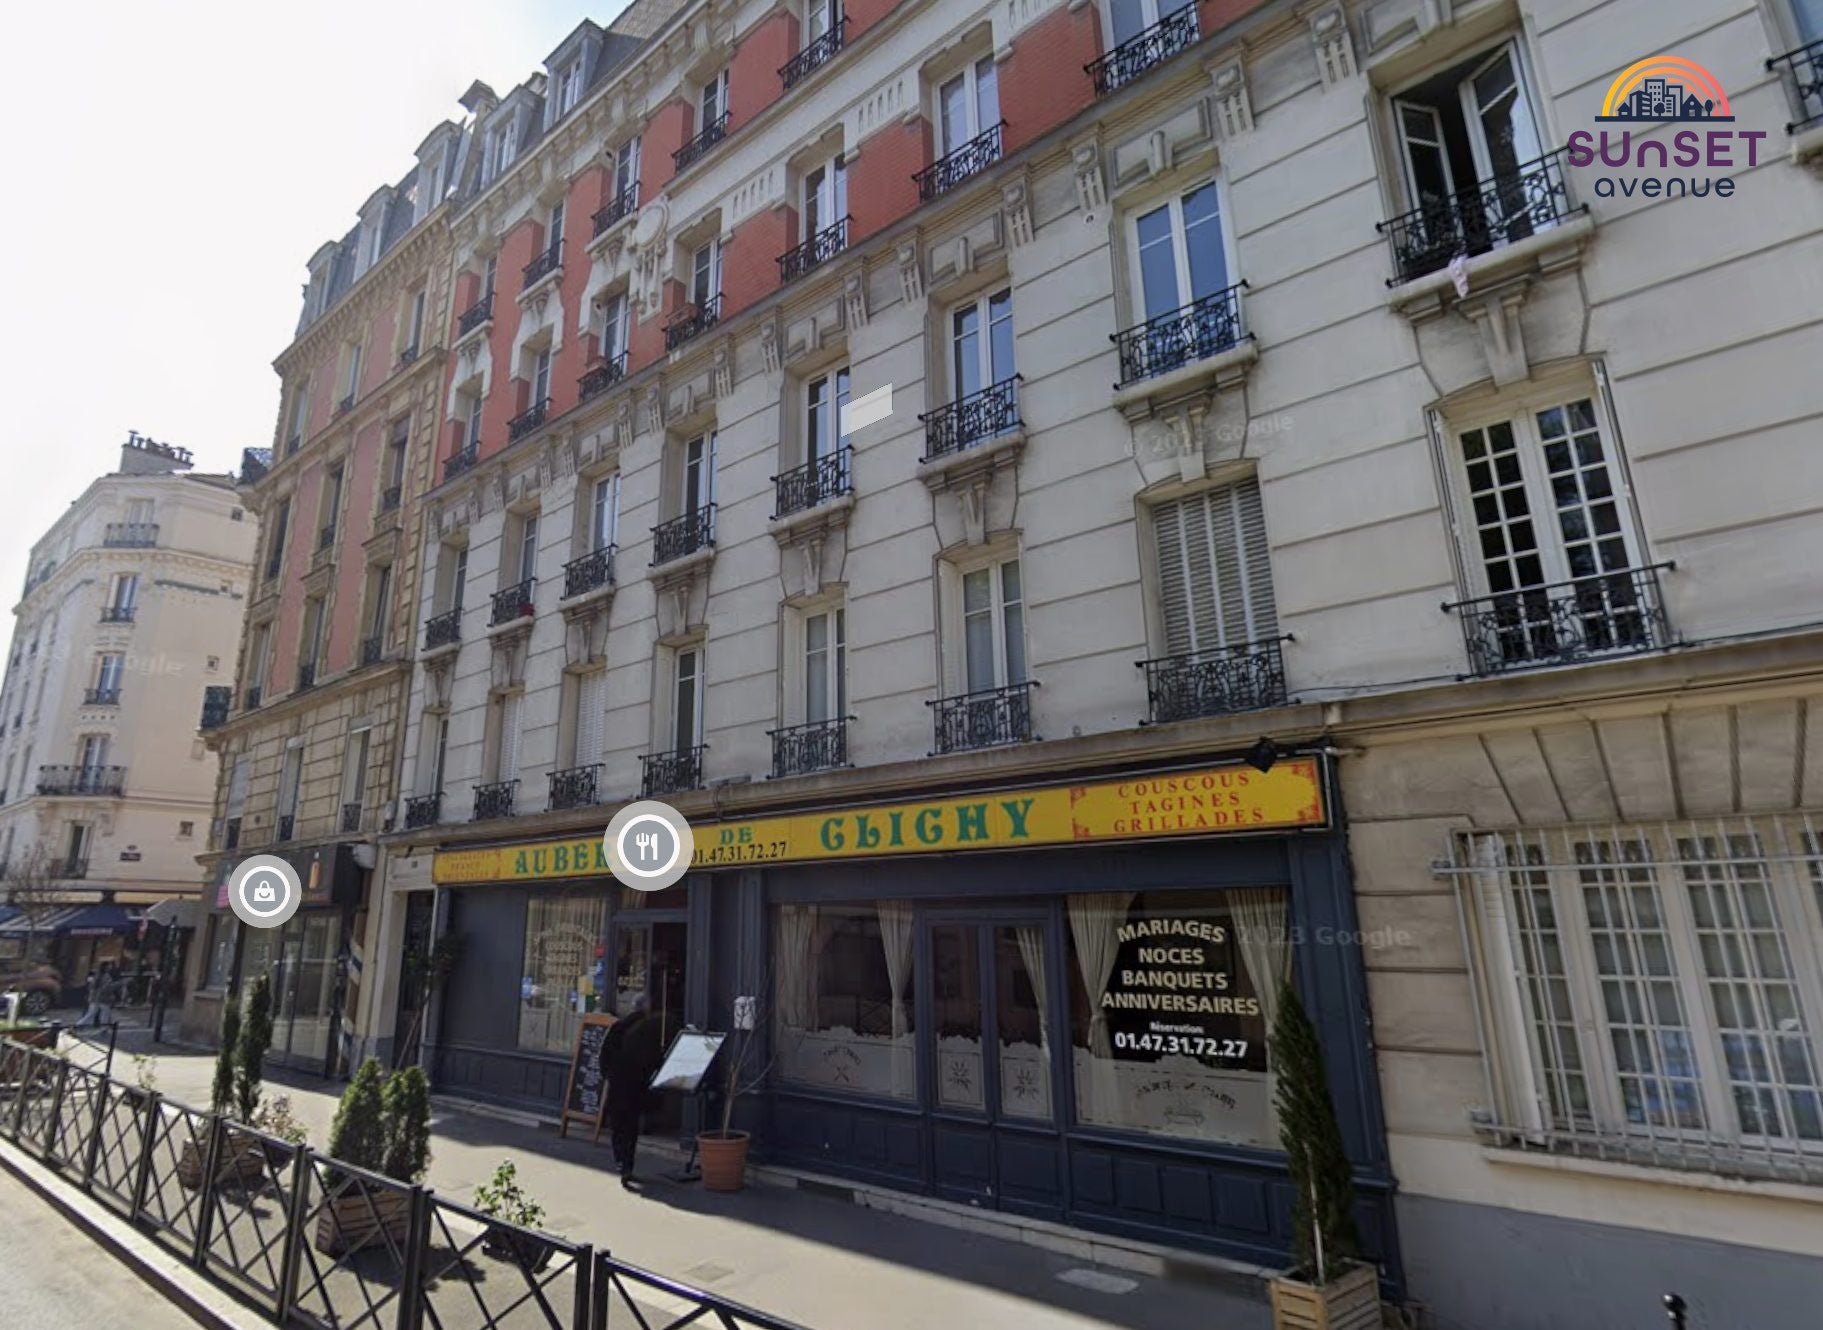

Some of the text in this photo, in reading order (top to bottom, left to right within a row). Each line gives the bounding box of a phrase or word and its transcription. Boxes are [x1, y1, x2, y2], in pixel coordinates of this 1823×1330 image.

[1118, 772, 1249, 798] COUSCOUS
[1129, 792, 1240, 815] TAGINES
[720, 827, 752, 845] DE
[819, 798, 1035, 851] CLICHY
[1113, 807, 1264, 833] GRILLADES
[1116, 918, 1226, 943] MARIAGES
[1138, 947, 1205, 965] NOCES
[1121, 969, 1229, 990] BANQUETS
[1101, 991, 1260, 1016] ANNIVERSAIRES
[1114, 1031, 1248, 1058] 01.47.31.72.27
